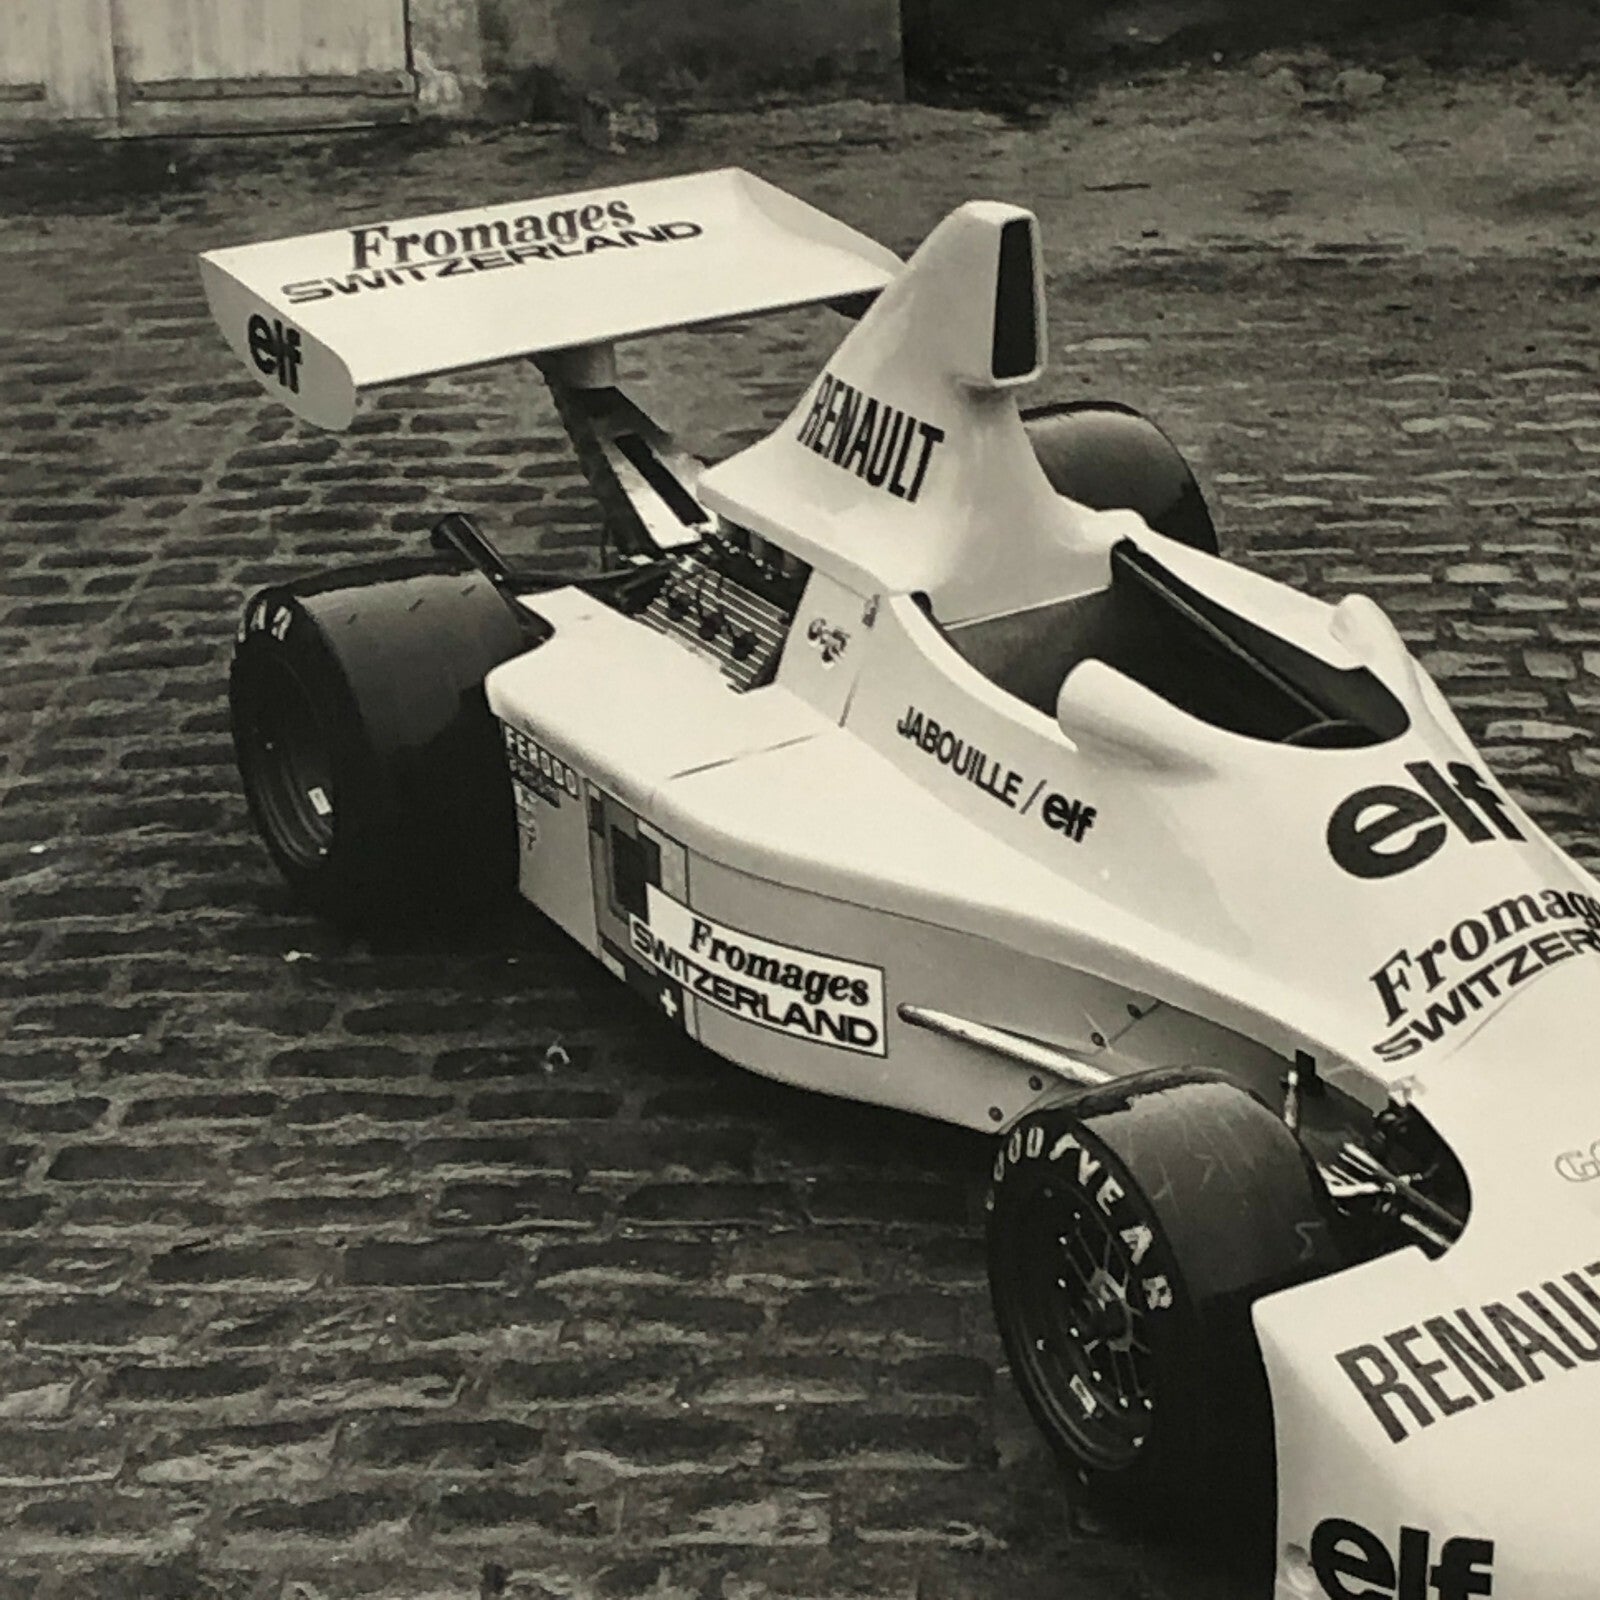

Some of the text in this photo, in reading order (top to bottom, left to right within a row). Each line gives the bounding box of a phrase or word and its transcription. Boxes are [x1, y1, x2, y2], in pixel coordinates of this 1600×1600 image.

[281, 222, 703, 304] SWITZERLAND
[347, 200, 635, 271] Fromages
[248, 313, 303, 391] elf
[797, 371, 945, 503] RENAULT
[897, 706, 1024, 809] JABOUILLE
[1041, 793, 1098, 843] elf
[1326, 760, 1529, 880] elf
[633, 919, 879, 1048] SWITZERLAND
[689, 917, 870, 1007] Fromages
[1335, 1261, 1600, 1445] RENAU
[1310, 1518, 1495, 1600] elf
